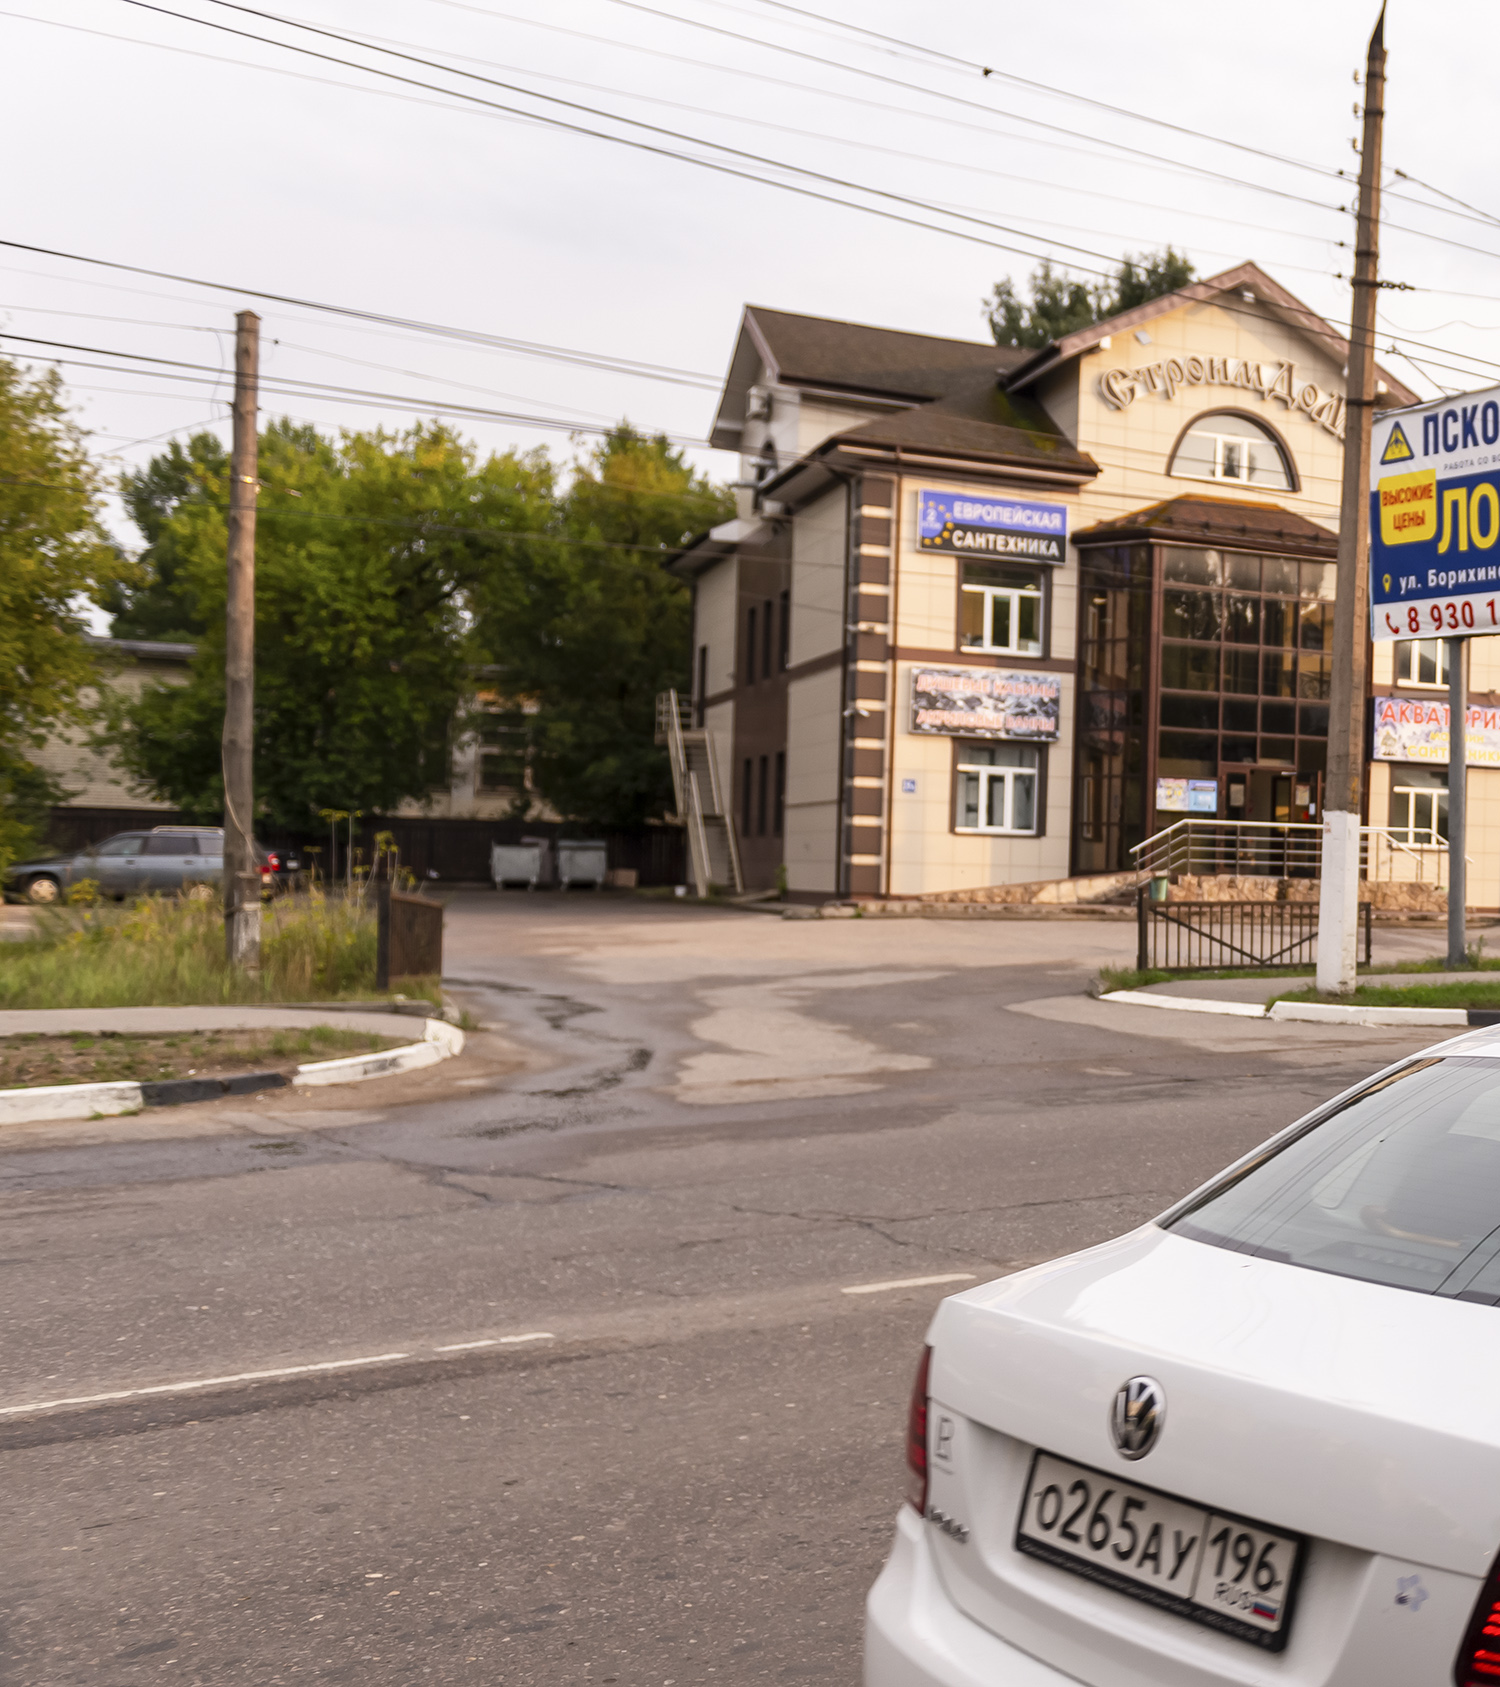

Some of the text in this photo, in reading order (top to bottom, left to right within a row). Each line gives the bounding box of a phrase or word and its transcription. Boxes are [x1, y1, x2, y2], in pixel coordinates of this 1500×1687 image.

[1443, 459, 1475, 470] РАБОТА
[1477, 456, 1489, 465] СО
[1382, 483, 1434, 507] ВЫСОКИЕ
[953, 500, 1063, 531] ЕВРОПЕЙСКАЯ
[1393, 510, 1426, 532] ЦЕНЫ
[952, 530, 1060, 558] САНТЕХНИКА
[1400, 574, 1422, 594] ул.
[1408, 606, 1420, 633] 8
[1430, 600, 1475, 631] 930
[1210, 1526, 1277, 1592] 196
